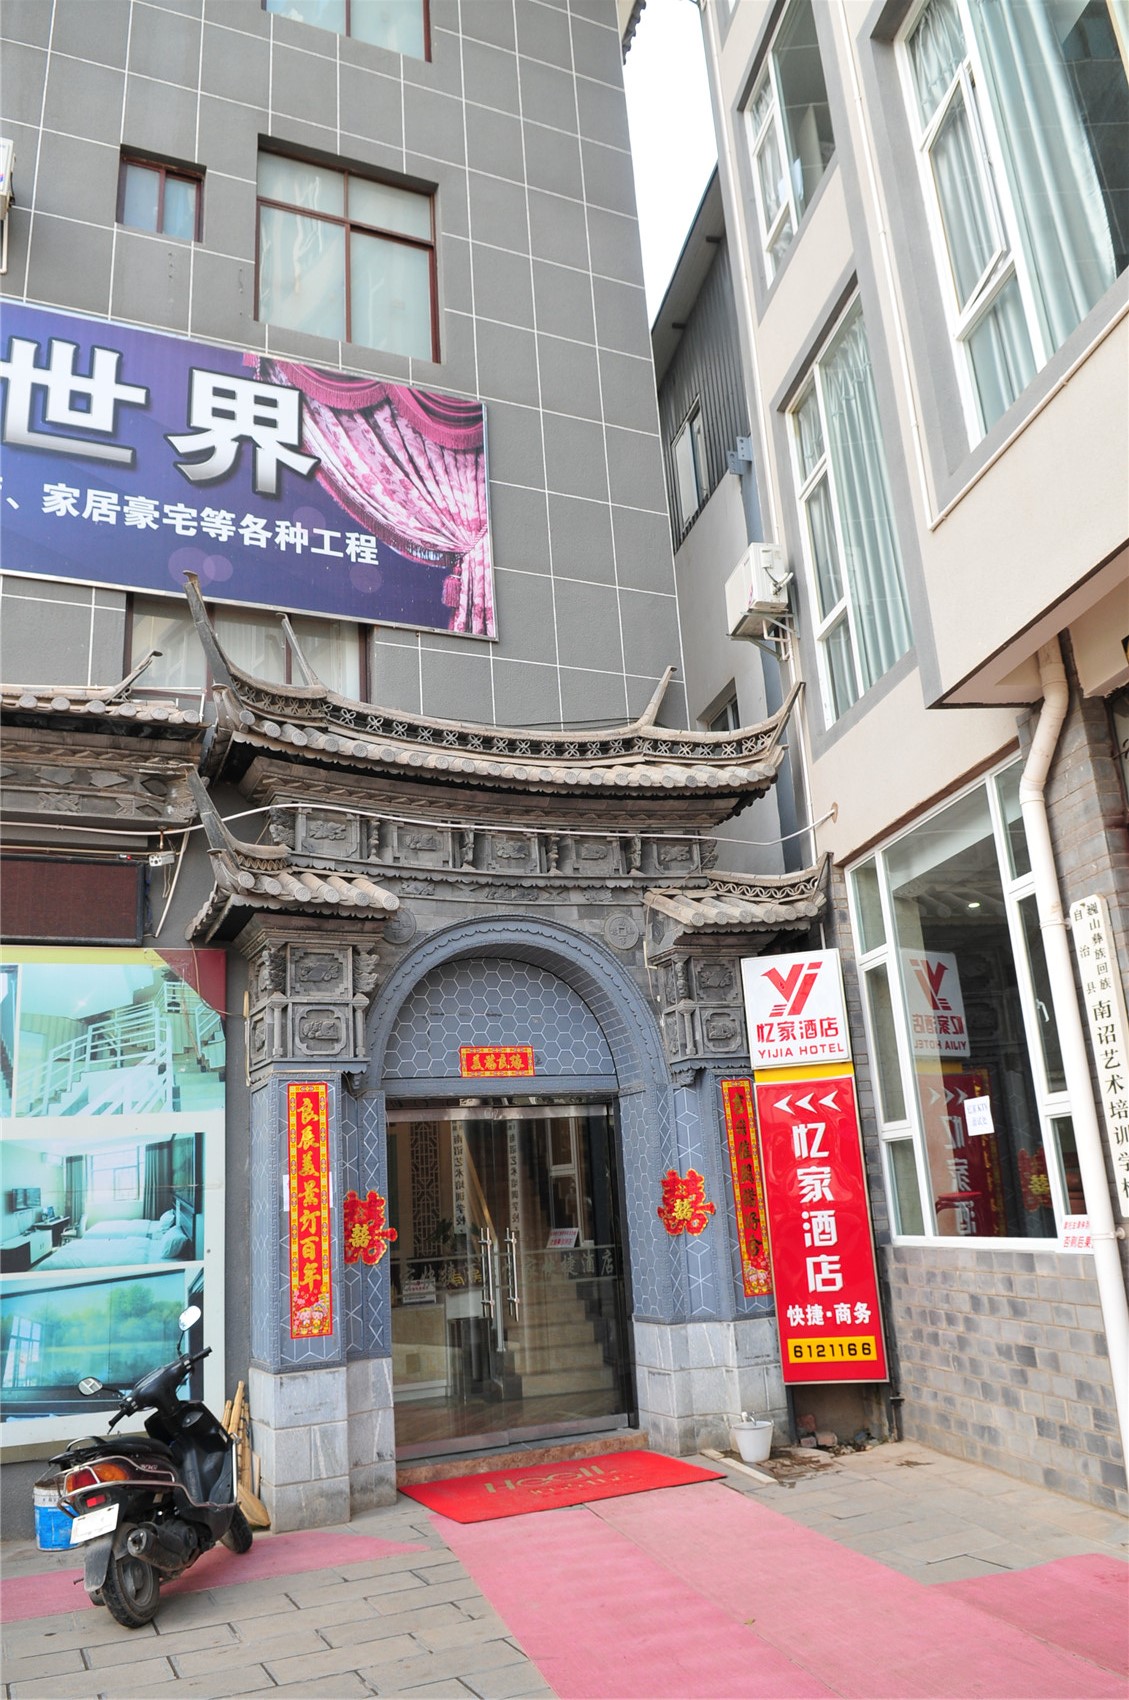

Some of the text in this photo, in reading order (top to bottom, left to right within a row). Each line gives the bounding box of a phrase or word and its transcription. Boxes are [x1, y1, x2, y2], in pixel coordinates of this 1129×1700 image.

[0, 337, 320, 495] 世界
[0, 476, 379, 565] 、家居豪宅等各种工程
[756, 1017, 839, 1043] 忆家酒店
[758, 1042, 845, 1059] YIJIA HOTEL
[791, 1122, 843, 1293] 忆家酒店
[1064, 1236, 1093, 1249] 否则后果
[786, 1301, 871, 1327] 快捷·商务
[793, 1342, 871, 1359] 6121166
